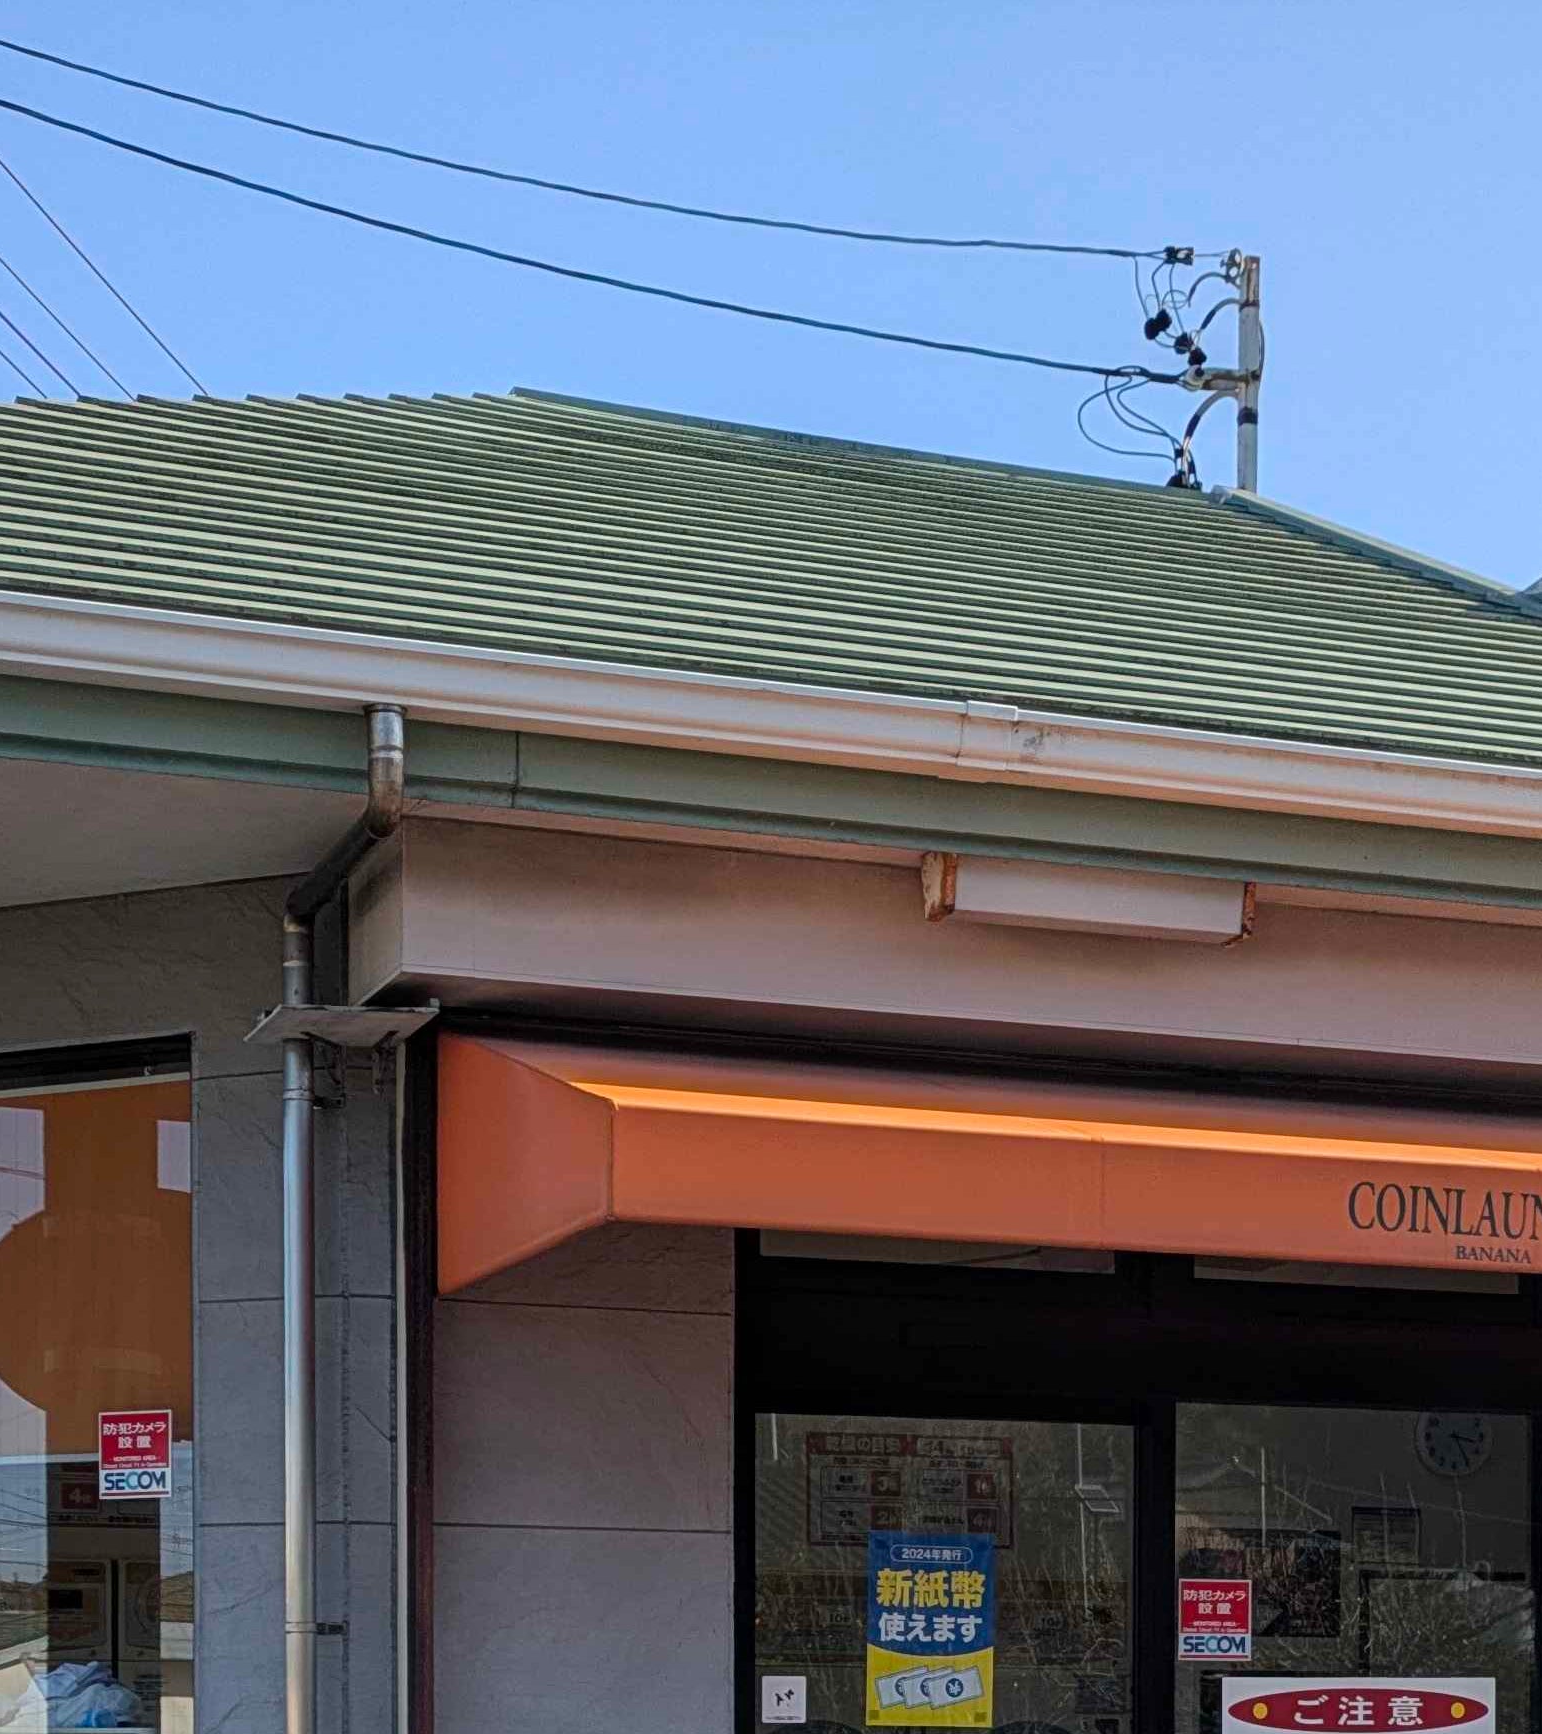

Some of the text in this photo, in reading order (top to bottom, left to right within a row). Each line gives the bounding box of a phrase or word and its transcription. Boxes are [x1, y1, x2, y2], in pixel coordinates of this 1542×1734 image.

[1454, 1245, 1532, 1265] BANANA
[102, 1421, 167, 1436] 防犯カメラ
[104, 1471, 166, 1491] SECOM
[901, 1548, 962, 1561] 2024年発行
[876, 1568, 986, 1609] 新紙幣
[1183, 1589, 1246, 1601] 防犯カメラ
[878, 1613, 983, 1643] 使えます
[1183, 1636, 1246, 1653] SECOM
[1293, 1694, 1424, 1727] ご注意
